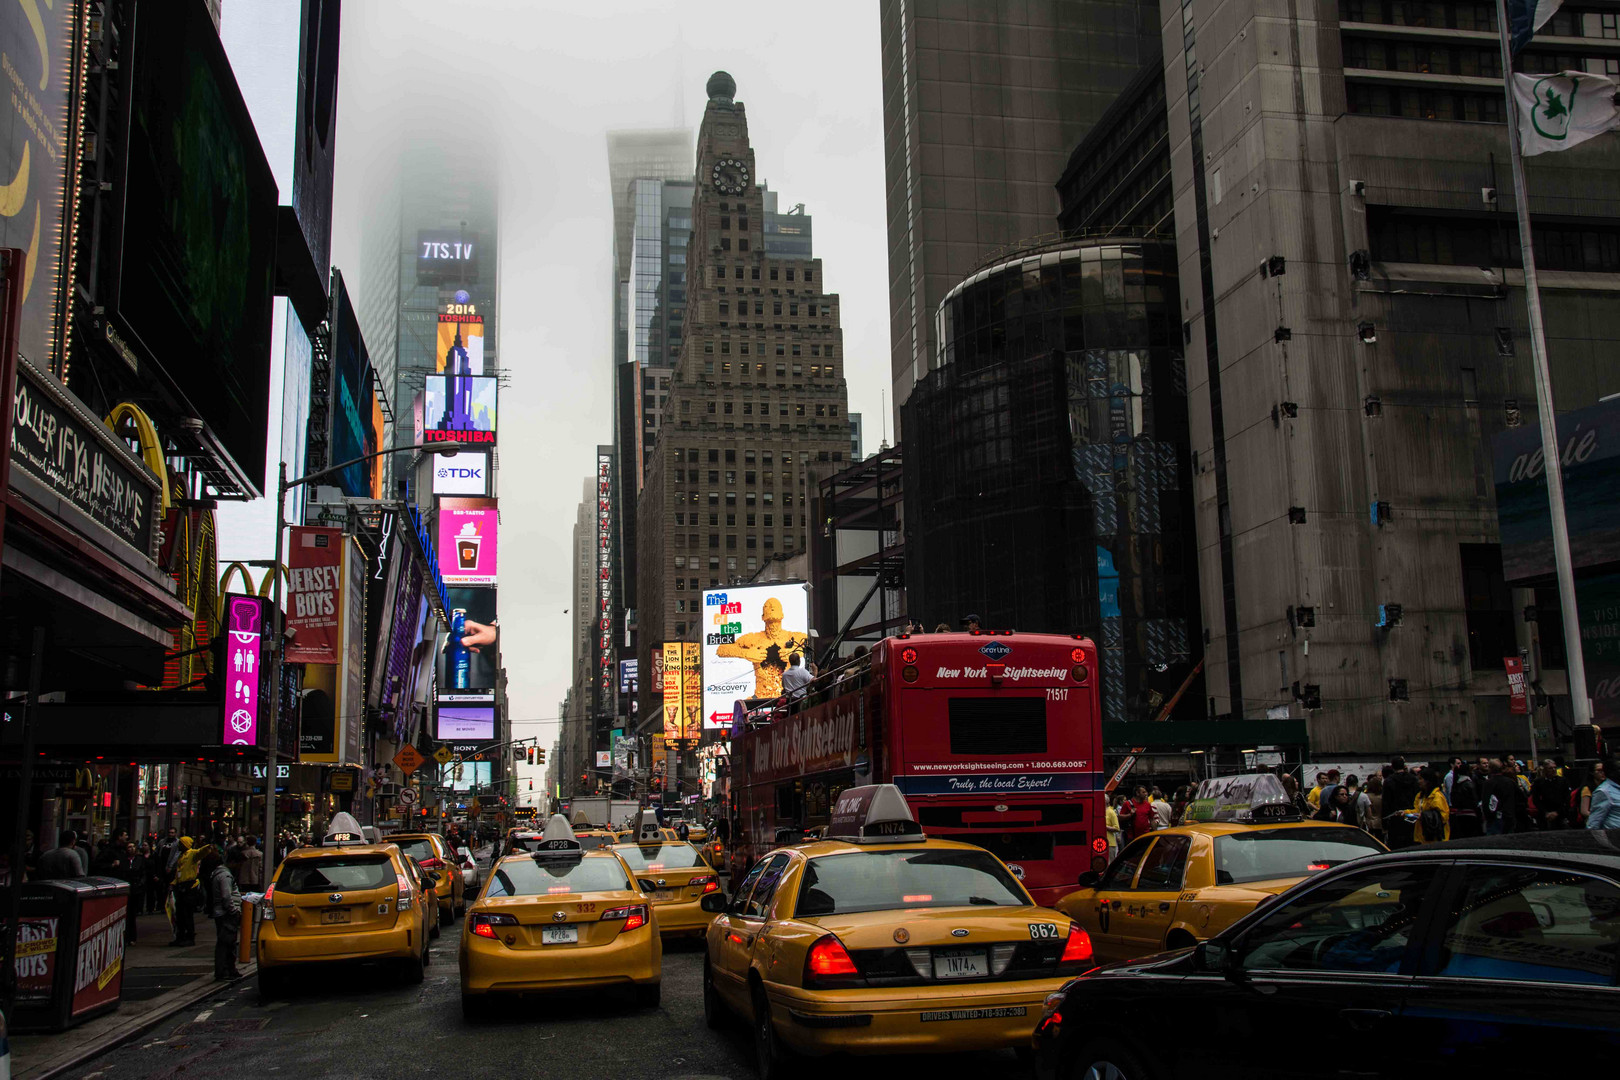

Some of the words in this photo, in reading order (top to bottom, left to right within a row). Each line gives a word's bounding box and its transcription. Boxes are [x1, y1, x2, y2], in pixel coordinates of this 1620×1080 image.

[423, 242, 473, 259] 7TS.TV
[446, 304, 476, 315] 2014
[439, 314, 483, 323] TOSHIBA
[425, 430, 494, 442] TOSHIBA
[1510, 424, 1597, 484] aeie
[448, 468, 481, 478] TDK
[93, 451, 125, 513] HEAR
[124, 480, 144, 530] ME
[321, 513, 350, 523] LAMAR
[288, 565, 341, 593] JERSEY
[295, 591, 335, 618] BOYS
[708, 596, 727, 605] The
[724, 605, 738, 614] Art
[716, 616, 726, 625] of
[724, 624, 739, 634] the
[710, 635, 733, 645] Brick
[665, 664, 681, 672] KING
[936, 667, 961, 678] New
[963, 667, 988, 678] York
[1002, 667, 1068, 681] Sightseeing
[1046, 689, 1068, 701] 71517
[755, 736, 770, 773] New
[771, 726, 790, 769] York
[791, 704, 855, 775] Sightseeing
[913, 762, 1024, 771] www.newyorksightseeing.com
[949, 778, 977, 791] Truly,
[979, 778, 993, 788] the
[994, 776, 1015, 788] local
[1018, 776, 1052, 789] Expert!
[1264, 806, 1287, 816] 4Y38
[879, 822, 905, 834] 1N74
[549, 840, 568, 849] 4P28
[576, 903, 596, 913] 332
[1030, 924, 1059, 938] 862
[75, 928, 107, 994] JERSEY
[105, 918, 127, 968] BOYS
[922, 1011, 950, 1021] DRIVERS
